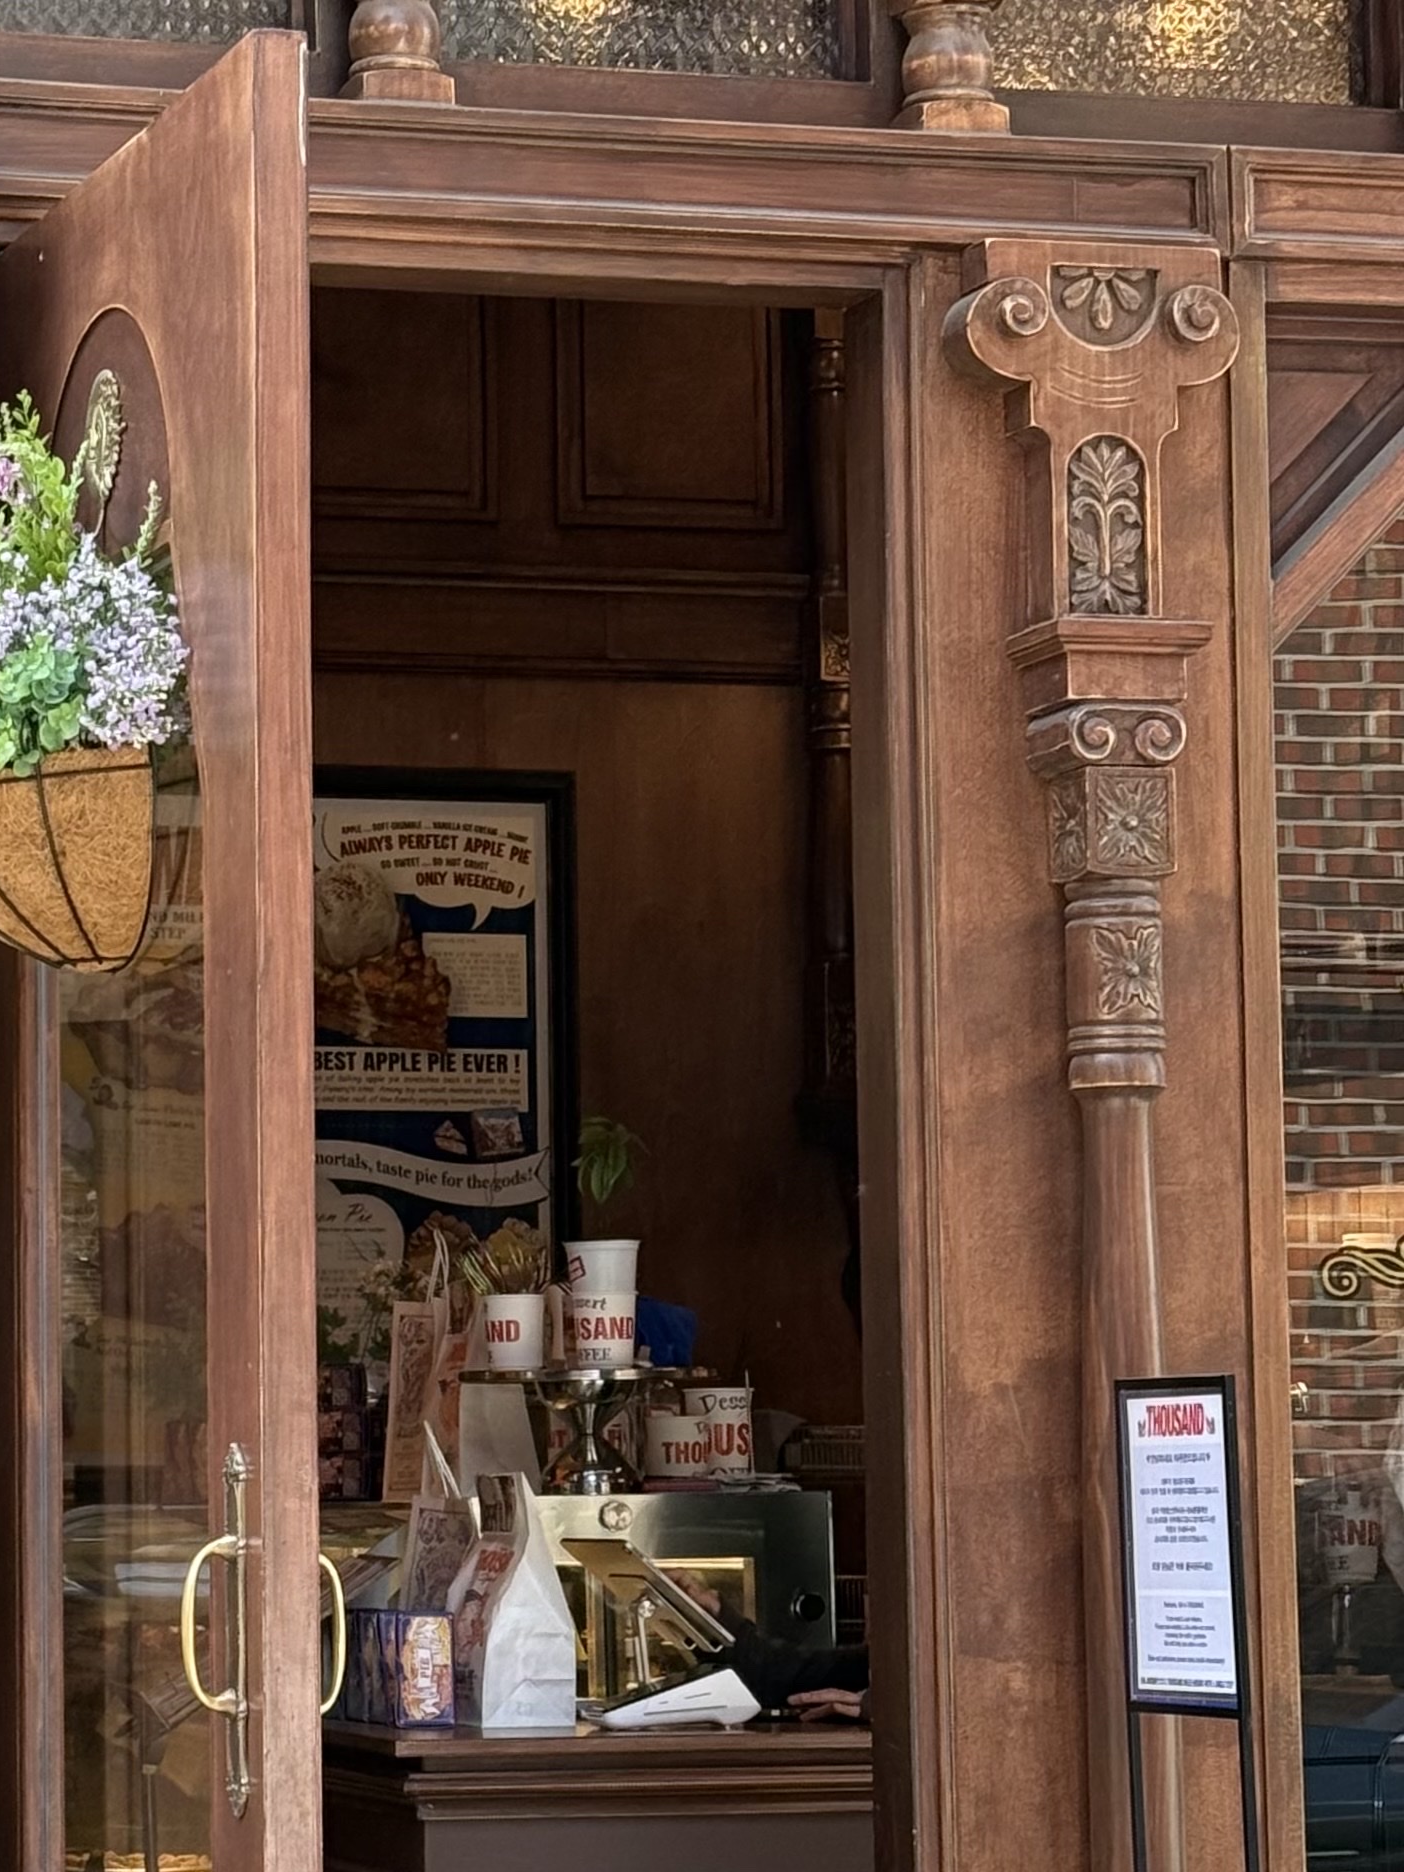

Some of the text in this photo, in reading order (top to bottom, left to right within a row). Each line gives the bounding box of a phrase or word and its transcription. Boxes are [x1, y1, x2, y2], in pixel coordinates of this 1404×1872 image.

[340, 834, 532, 865] ALWAYS PERFECT APPLE PIE
[416, 871, 448, 887] ONLY
[453, 872, 515, 894] WEEKEND
[314, 1051, 356, 1072] BEST
[363, 1052, 422, 1072] APPLE
[428, 1054, 456, 1072] PIE
[463, 1053, 509, 1073] EVER
[376, 1160, 412, 1179] taste
[415, 1166, 438, 1185] pie
[441, 1171, 464, 1188] for
[466, 1174, 490, 1189] the
[492, 1167, 533, 1192] gods!
[1146, 1403, 1205, 1438] THOUSAND
